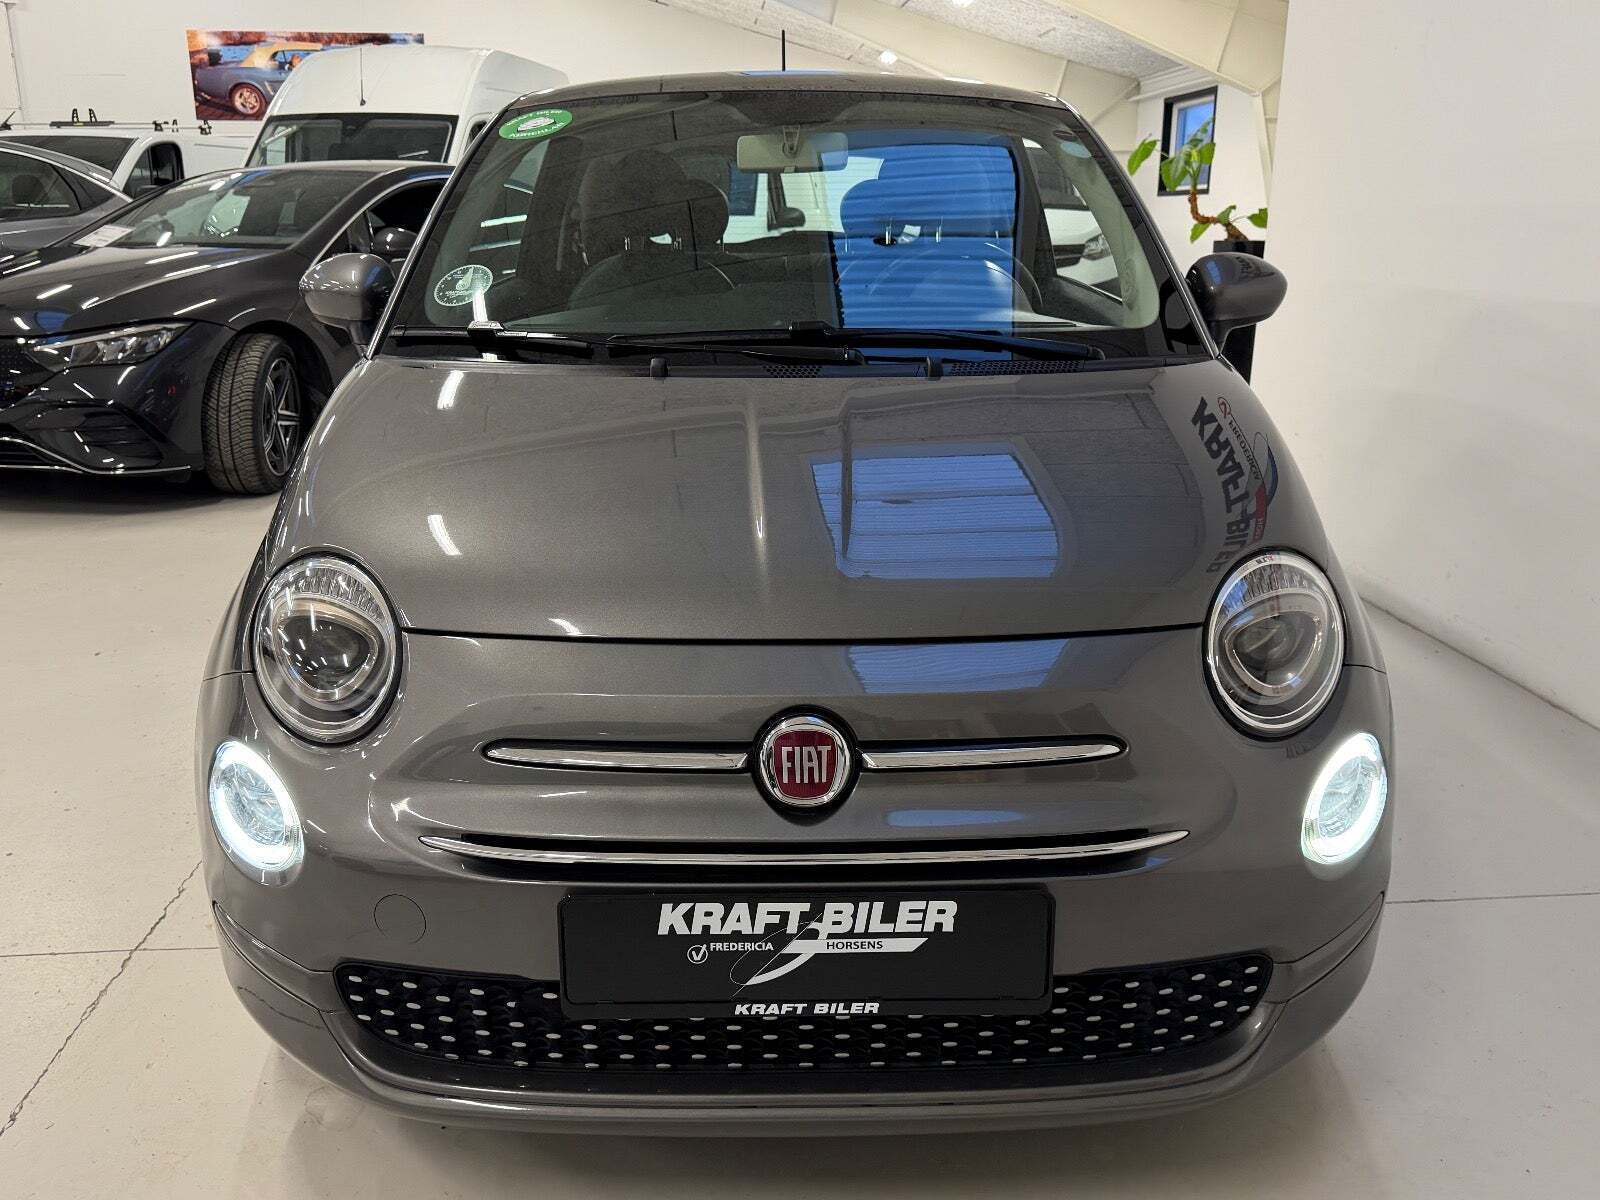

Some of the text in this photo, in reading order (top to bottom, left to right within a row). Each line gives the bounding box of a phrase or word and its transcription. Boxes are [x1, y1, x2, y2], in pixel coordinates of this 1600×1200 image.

[781, 745, 832, 784] FIAT
[657, 900, 958, 936] KRAFT BILER
[710, 941, 774, 952] FREDERICIA
[826, 940, 884, 951] HORSENS
[734, 1002, 880, 1016] KRAFT BILER
